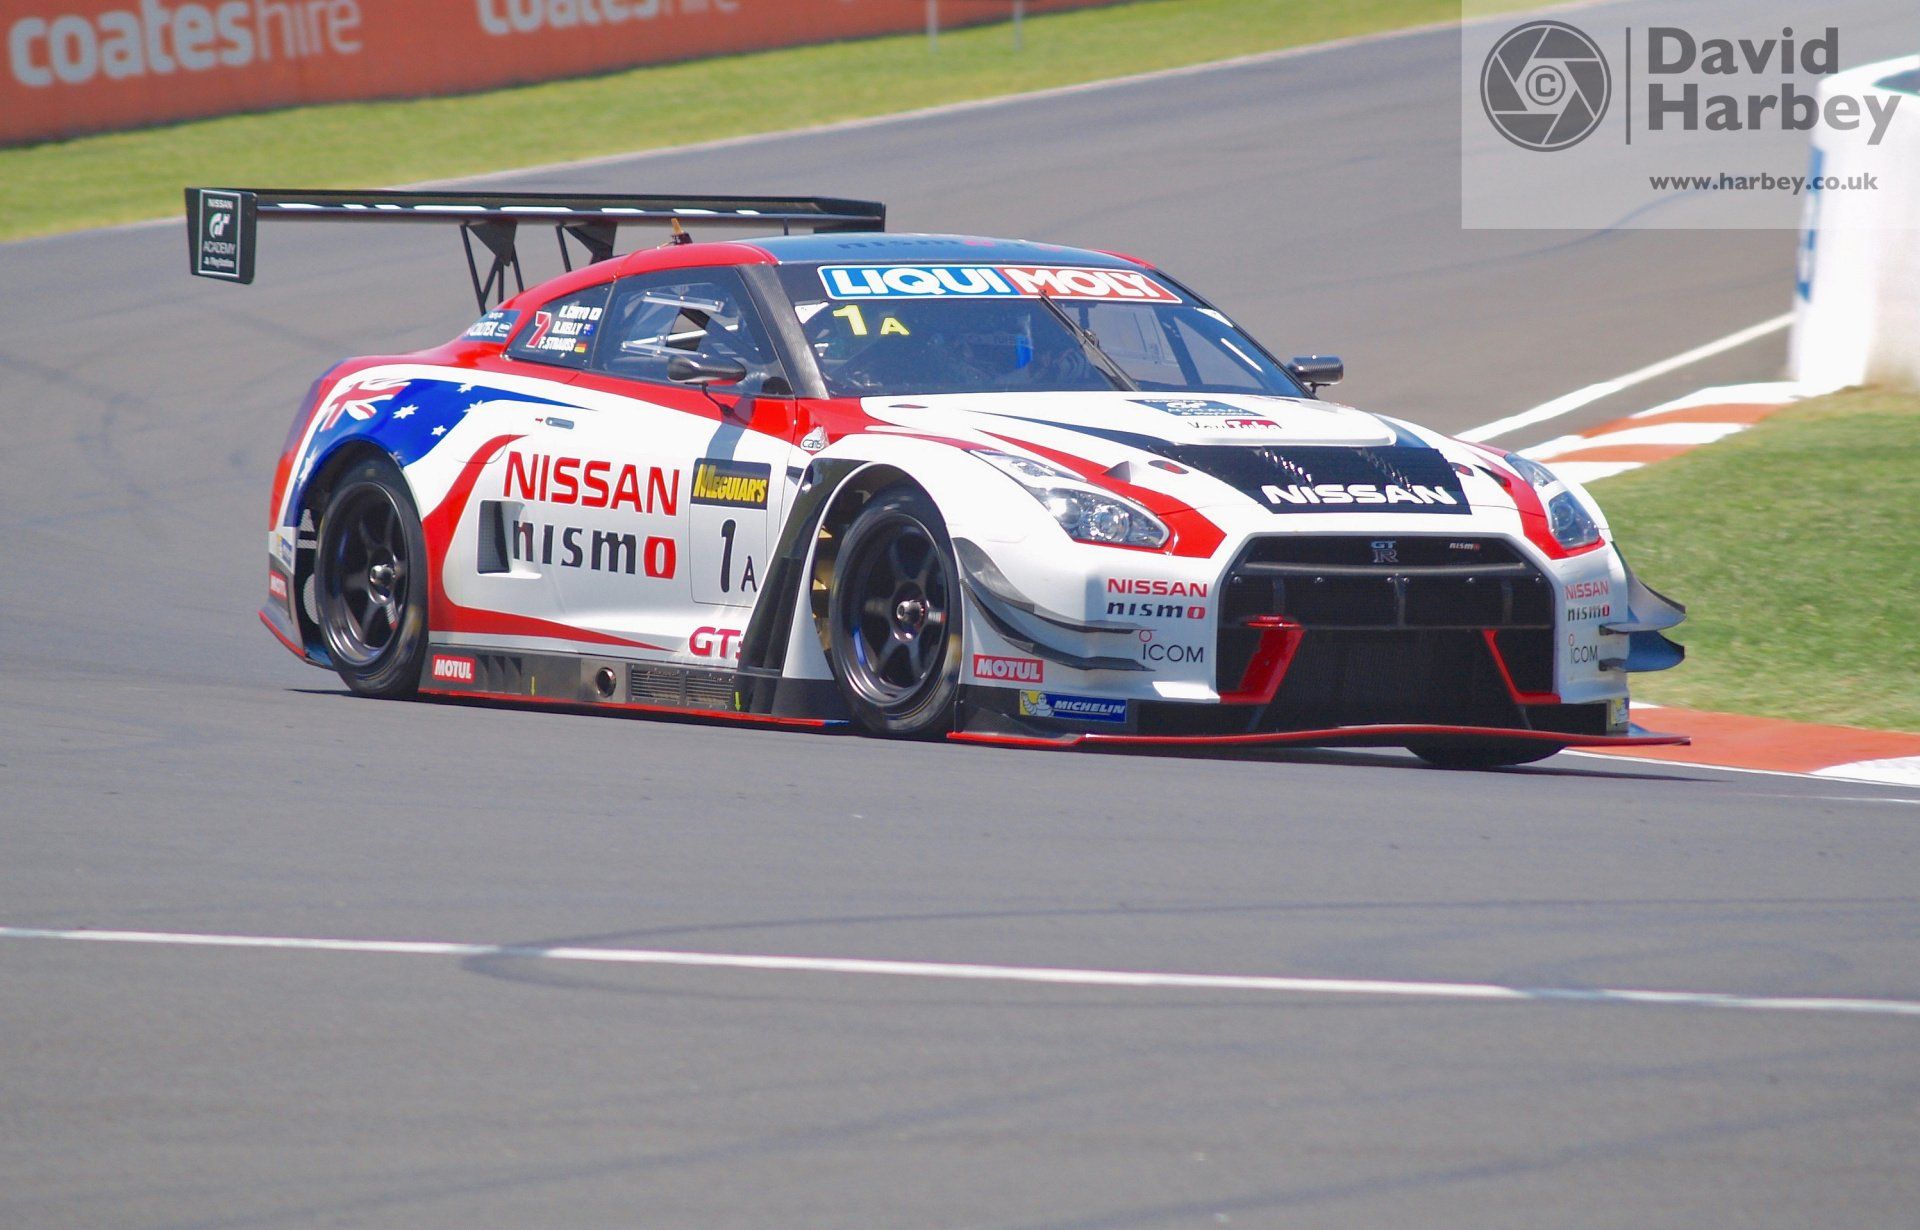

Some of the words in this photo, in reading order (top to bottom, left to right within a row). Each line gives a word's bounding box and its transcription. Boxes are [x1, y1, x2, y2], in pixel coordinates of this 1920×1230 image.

[207, 198, 233, 209] NISSAN
[829, 266, 1012, 295] LIQUI
[1003, 268, 1162, 298] MOLY
[832, 305, 868, 335] 1
[880, 317, 910, 335] A
[503, 451, 680, 516] NISSAN
[1261, 484, 1458, 505] NISSAN
[512, 520, 676, 580] nismo
[720, 519, 736, 593] 1
[740, 556, 758, 593] A
[1107, 578, 1208, 598] NISSAN
[1565, 580, 1609, 600] NISSAN
[1107, 602, 1206, 620] nismo
[1568, 605, 1610, 622] nismo
[434, 658, 472, 680] MOTUL
[975, 658, 1041, 681] MOTUL
[1053, 699, 1126, 715] MICHELIN
